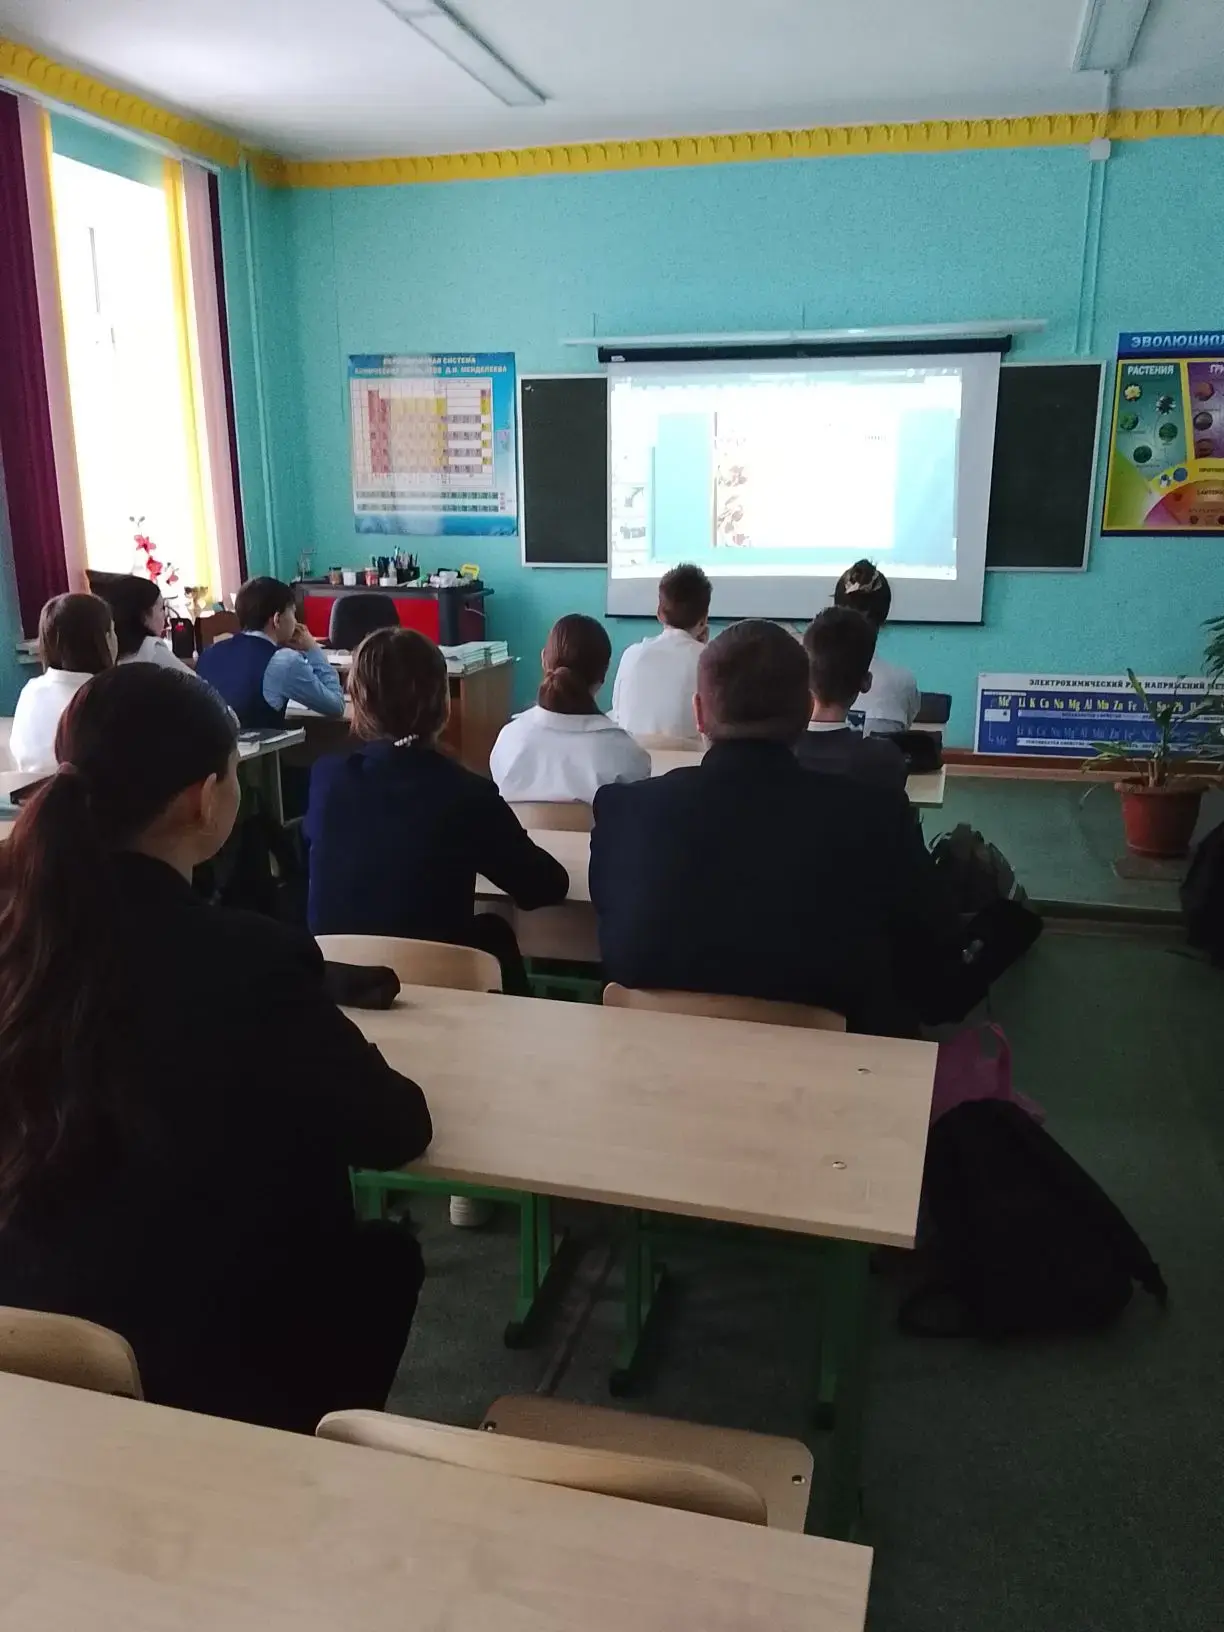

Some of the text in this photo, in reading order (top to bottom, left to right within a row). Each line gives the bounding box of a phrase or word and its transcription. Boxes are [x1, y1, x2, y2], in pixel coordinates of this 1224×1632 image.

[1131, 334, 1224, 348] ЭВОЛЮЦИО
[1128, 365, 1174, 375] РАСТЕНИЯ
[1029, 679, 1123, 688] ЭЛЕКТРОХИМИЧЕСКИЙ
[1068, 699, 1081, 712] Mg
